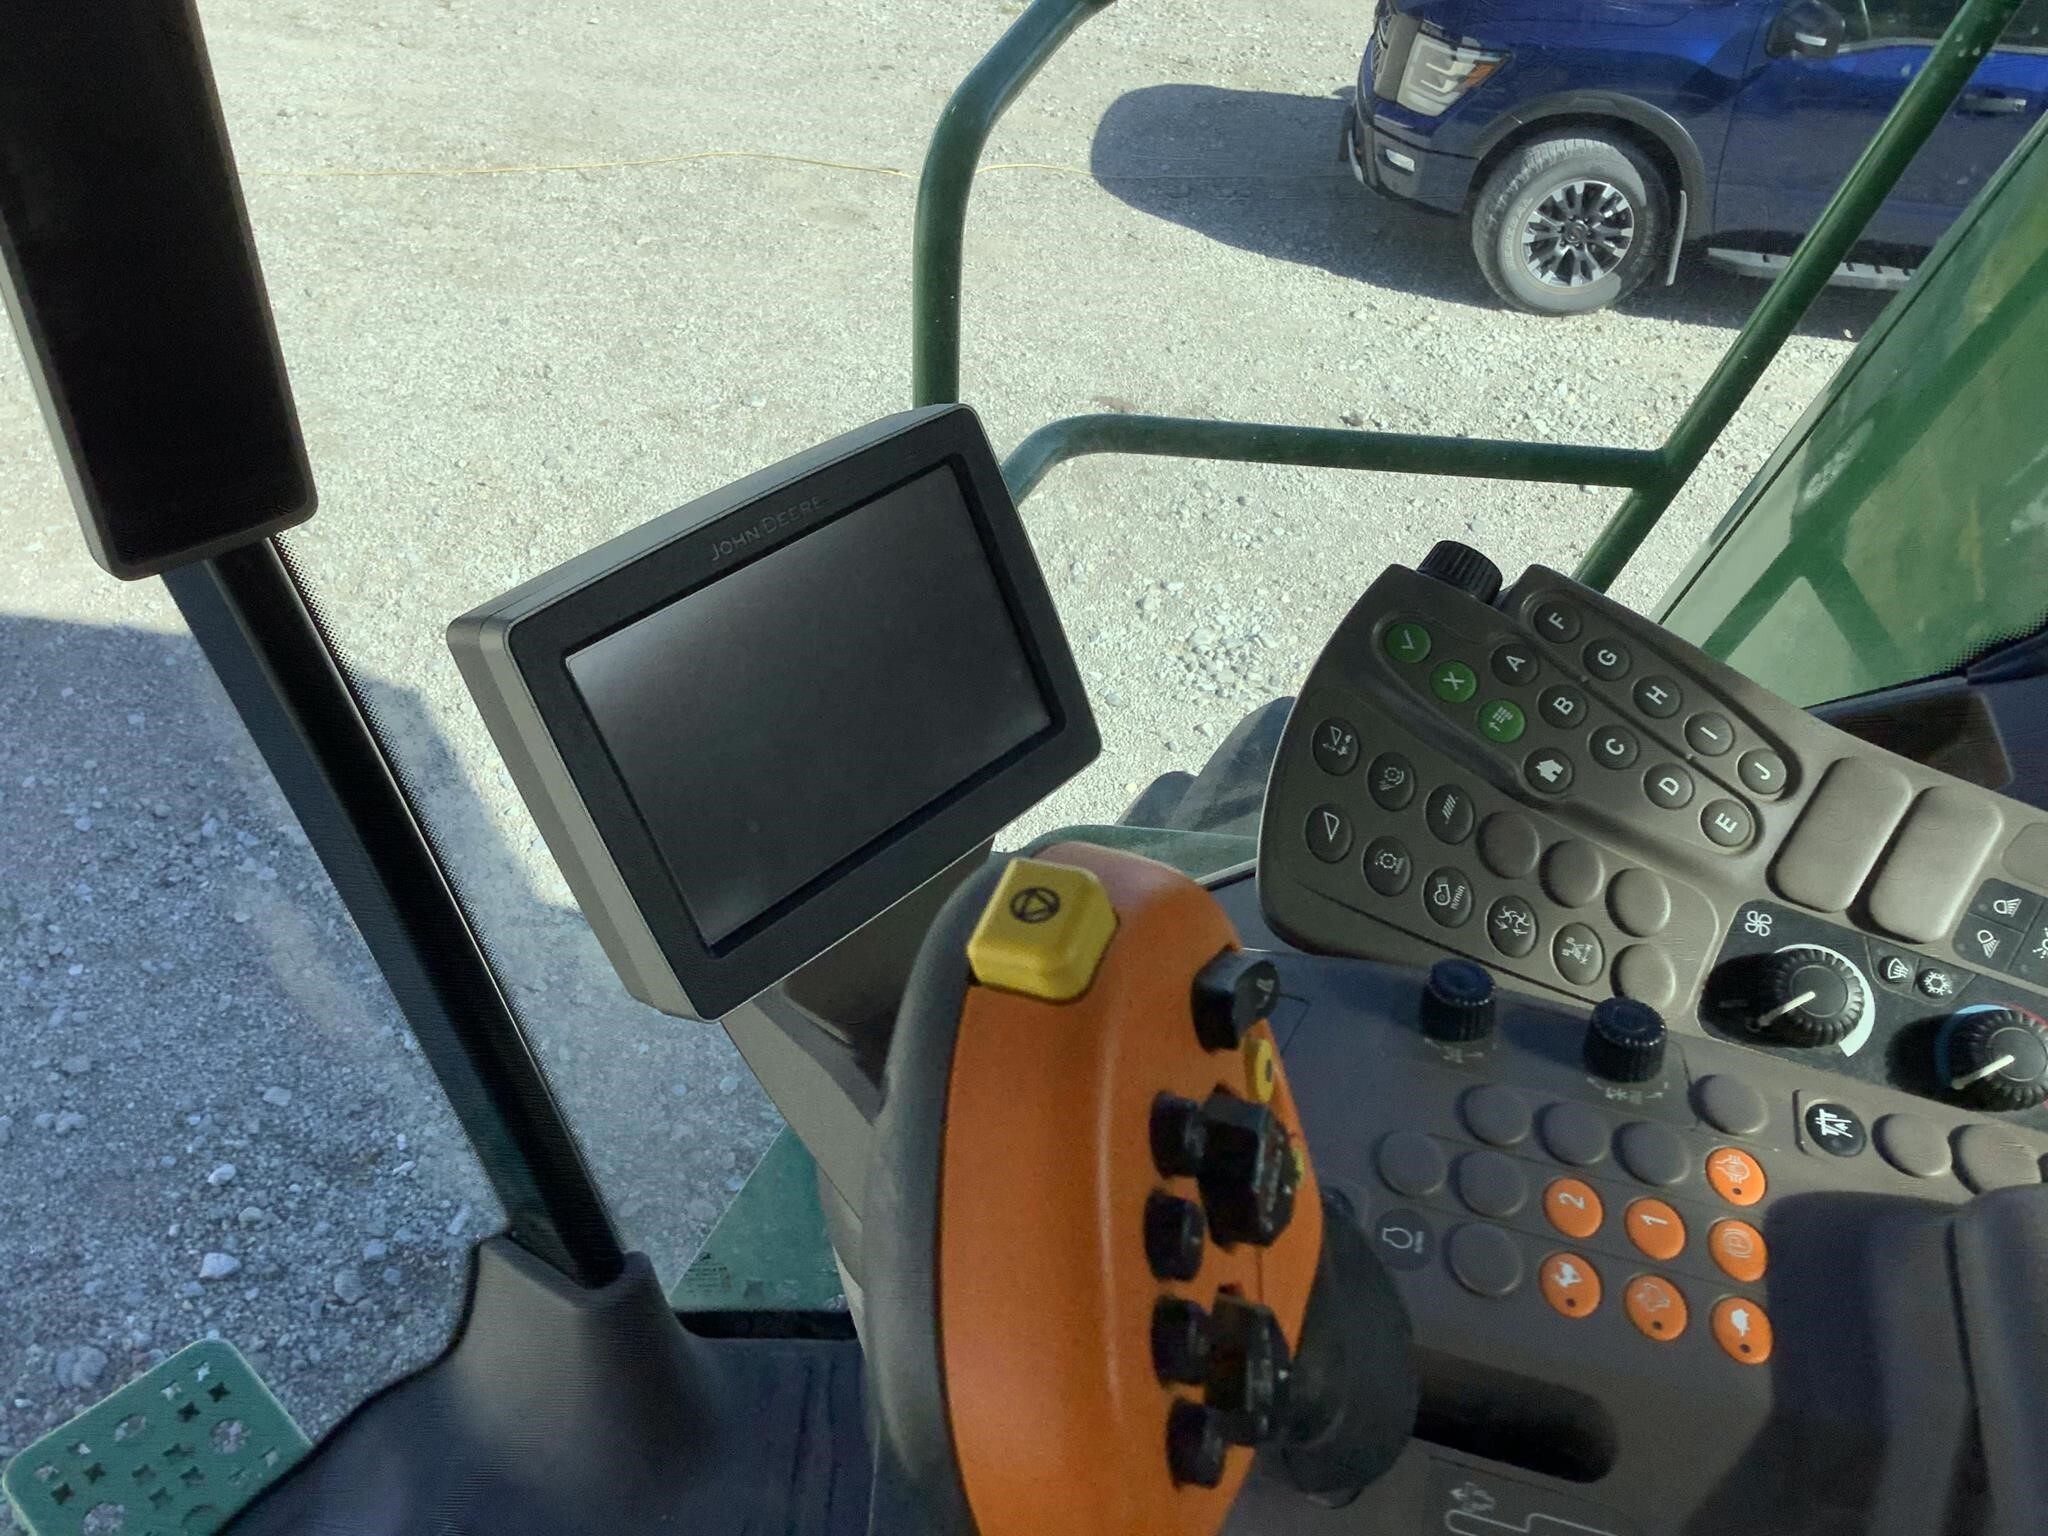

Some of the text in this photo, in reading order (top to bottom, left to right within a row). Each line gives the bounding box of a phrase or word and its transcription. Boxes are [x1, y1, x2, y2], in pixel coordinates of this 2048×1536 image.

[711, 496, 824, 562] JOHN DEERE
[1548, 612, 1565, 630] F
[1505, 653, 1526, 672] A
[1597, 649, 1617, 666] G
[1645, 685, 1669, 705] H
[1552, 696, 1575, 716] B
[1700, 725, 1719, 741] I
[1605, 738, 1625, 756] C
[1754, 761, 1772, 781] J
[1658, 776, 1680, 796] D
[1714, 812, 1739, 834] E
[1558, 1191, 1585, 1210] 2
[1640, 1214, 1669, 1226] 1
